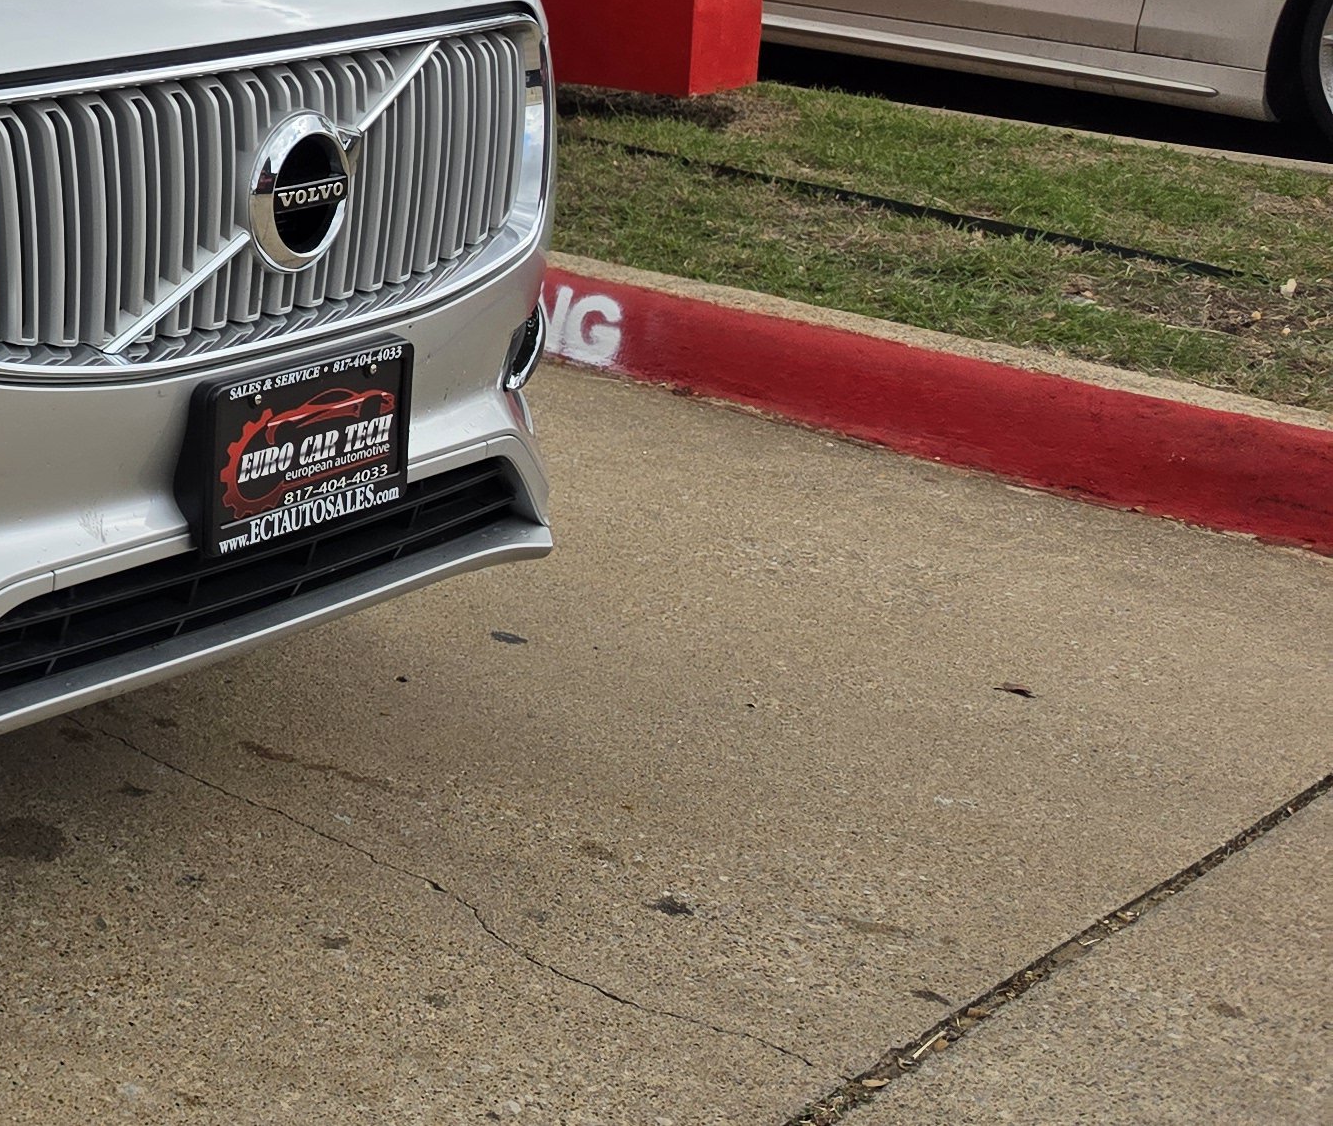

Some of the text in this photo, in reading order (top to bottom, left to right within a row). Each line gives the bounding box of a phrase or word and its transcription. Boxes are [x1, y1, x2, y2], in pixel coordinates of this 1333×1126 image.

[278, 181, 344, 207] VOLVO
[230, 346, 402, 400] SALES & SERVICE 817-404-4033
[238, 414, 393, 483] EURO CAR TECH
[285, 442, 391, 481] european automotive
[284, 464, 388, 505] 817-404-4033
[219, 483, 399, 554] www.ECTAUTOSALES.com
